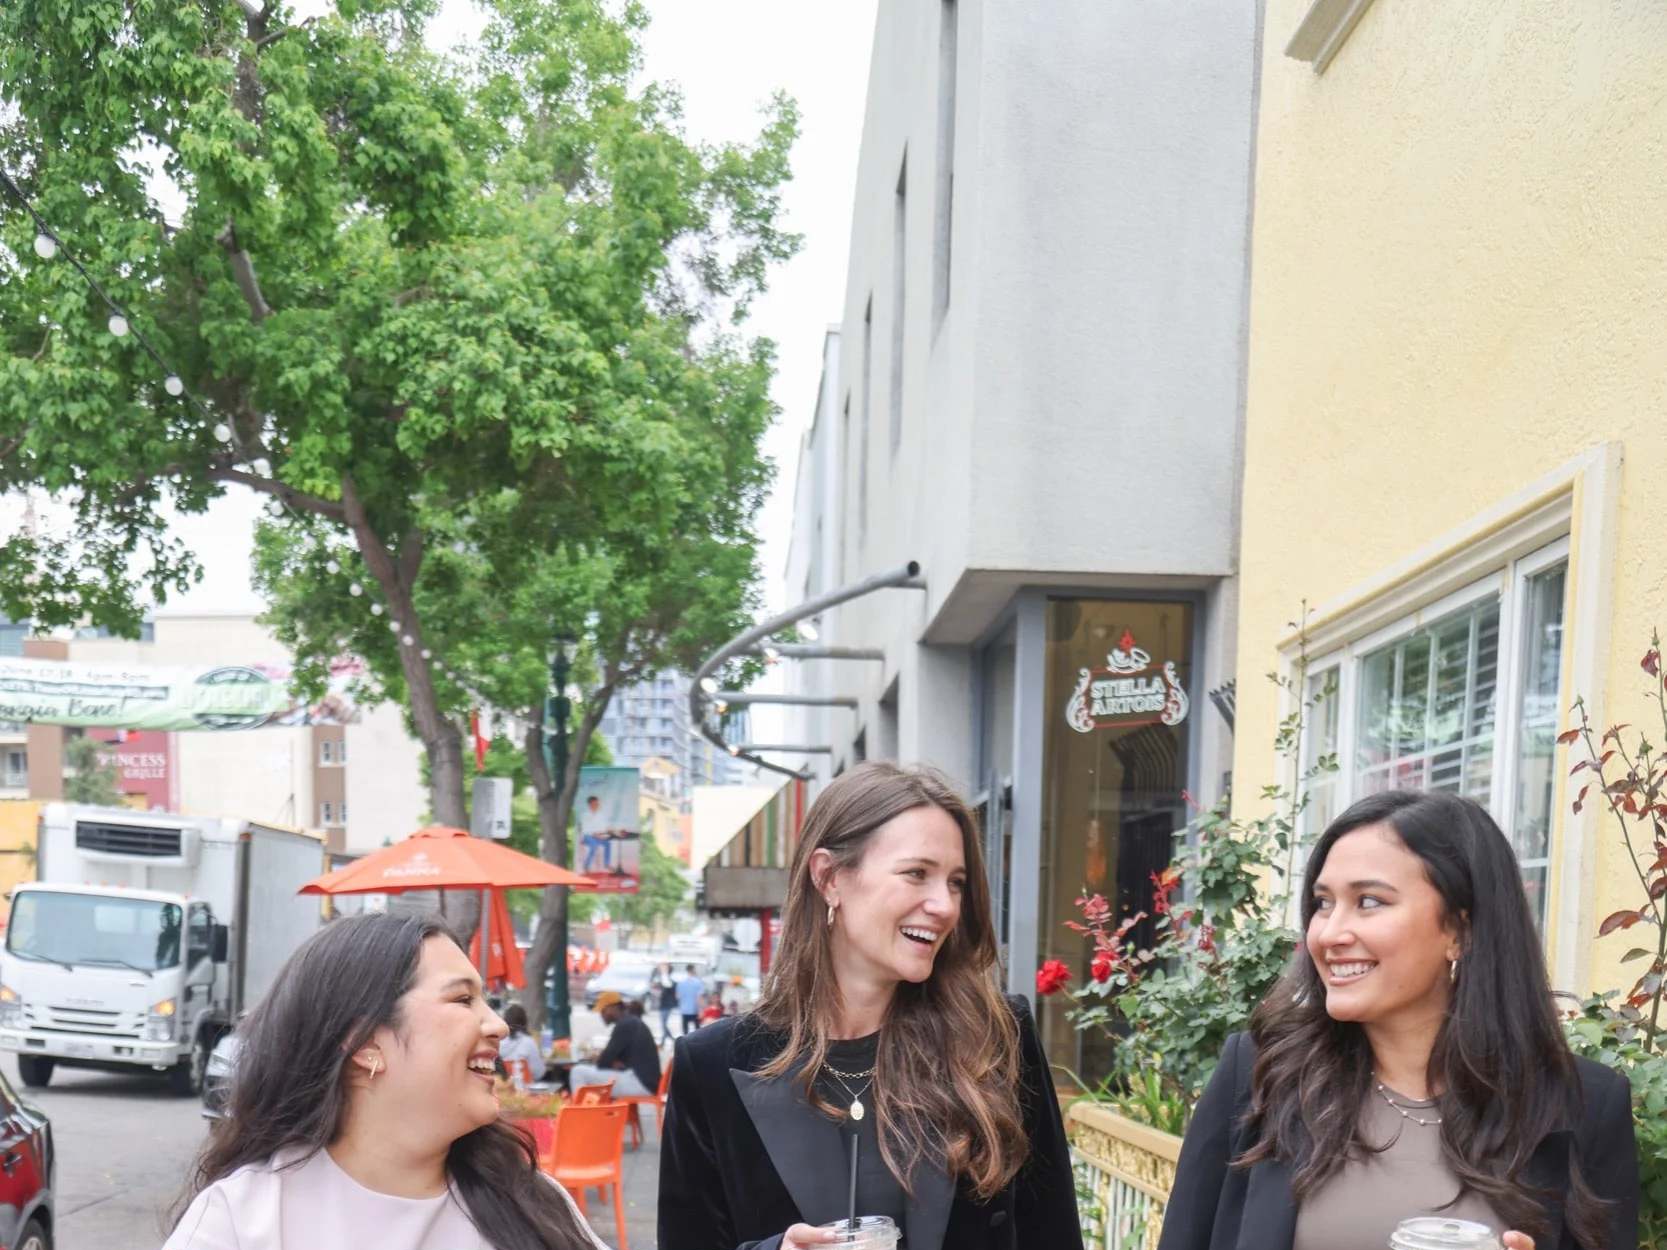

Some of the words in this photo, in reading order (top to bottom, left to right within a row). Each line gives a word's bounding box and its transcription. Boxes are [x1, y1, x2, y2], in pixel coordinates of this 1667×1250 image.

[1090, 676, 1166, 698] STELLA
[1090, 694, 1166, 715] ARTOIS
[97, 752, 166, 768] INCESS
